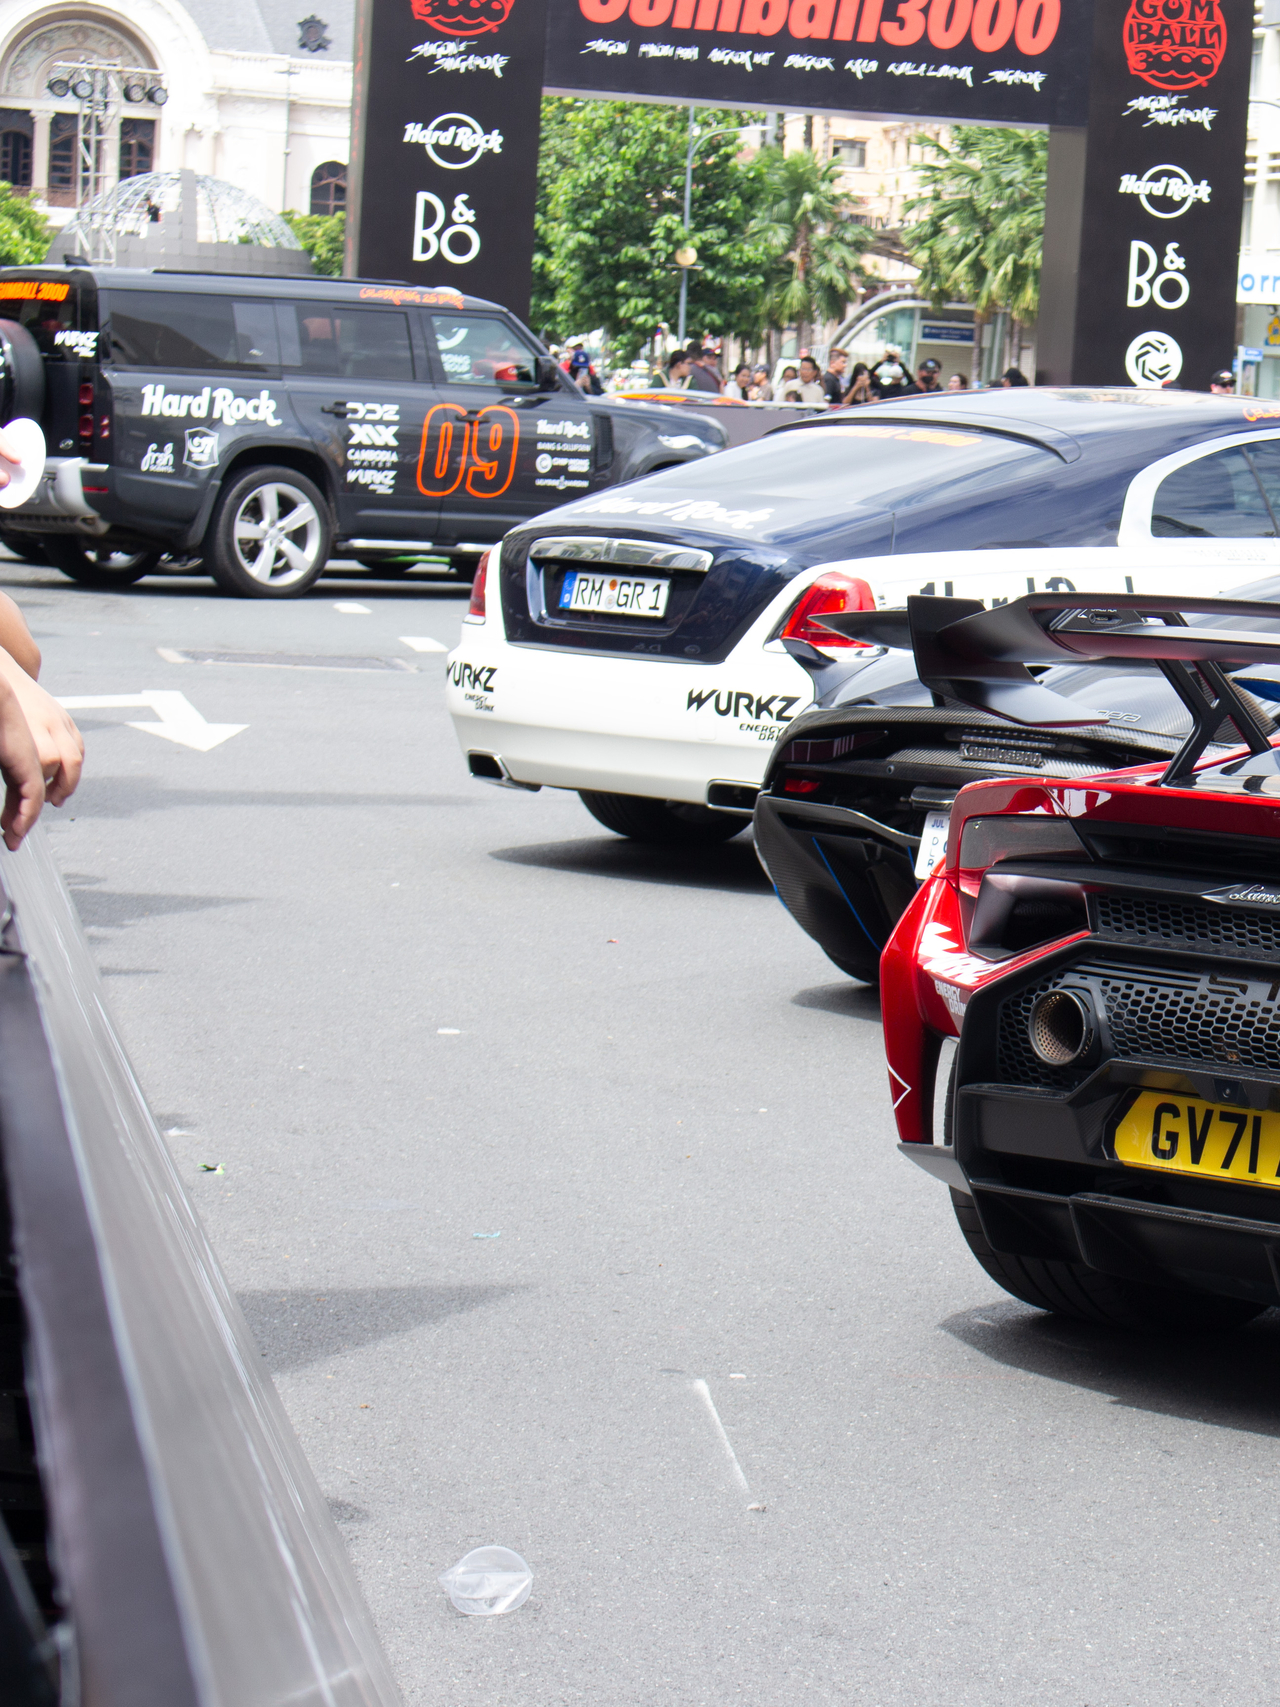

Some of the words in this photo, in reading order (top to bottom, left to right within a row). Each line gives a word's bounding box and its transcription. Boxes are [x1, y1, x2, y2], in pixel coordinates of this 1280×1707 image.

[1131, 22, 1220, 49] BALL
[403, 122, 453, 145] Hard
[453, 126, 504, 153] Rock
[1119, 173, 1169, 197] Hard
[1165, 178, 1212, 203] Rock
[141, 384, 212, 418] Hard
[212, 387, 283, 427] Rock
[537, 419, 564, 435] Hard
[563, 421, 591, 439] Rock
[417, 403, 520, 498] 09
[575, 577, 605, 606] RM
[616, 581, 645, 610] GR
[648, 583, 662, 611] 1
[686, 687, 802, 723] WURKZ
[738, 722, 786, 736] ENERGY
[931, 819, 945, 829] JUL
[1151, 1102, 1262, 1174] GV71
